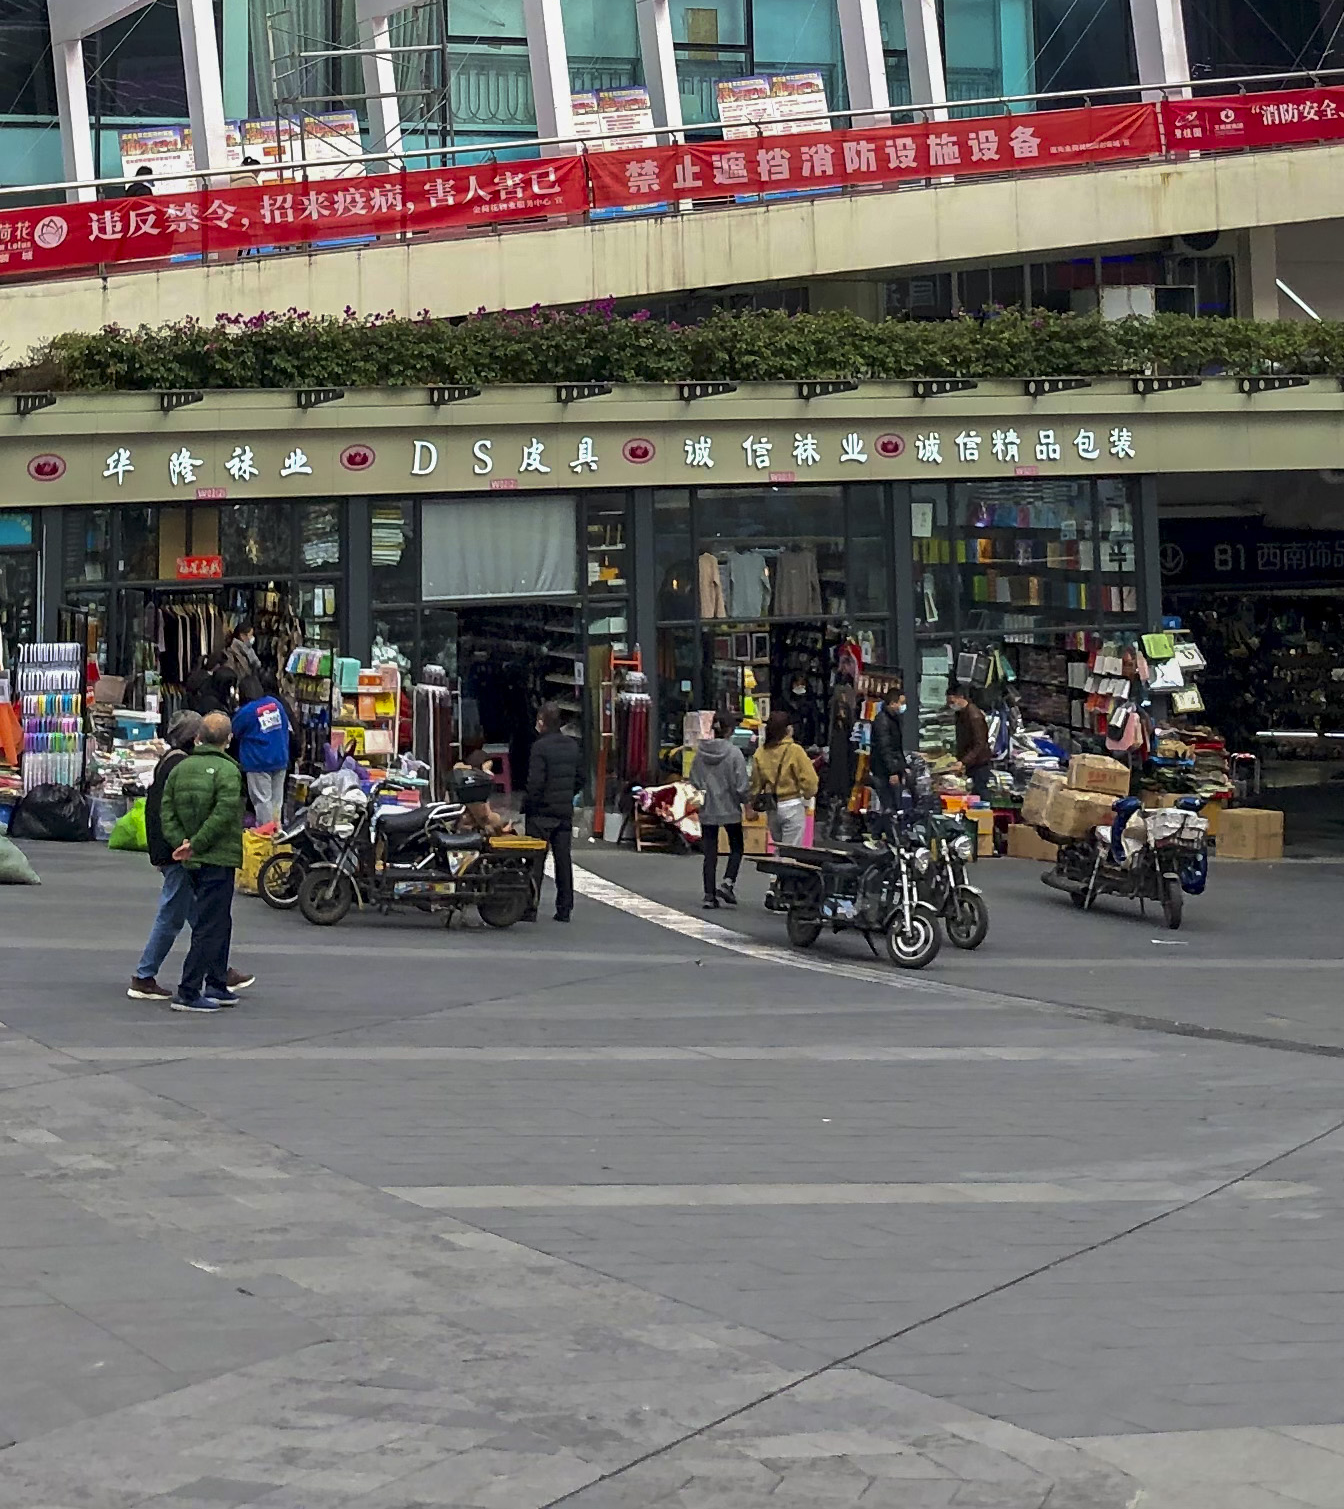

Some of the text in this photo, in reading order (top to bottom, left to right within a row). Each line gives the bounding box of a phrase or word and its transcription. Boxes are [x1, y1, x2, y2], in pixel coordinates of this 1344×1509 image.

[625, 125, 1042, 194] 禁止遮挡消防设施设备
[7, 241, 32, 250] Lotus
[103, 445, 313, 487] 华隆袜业
[684, 432, 868, 470] 诚信袜业
[915, 427, 1137, 466] 诚信精品包装
